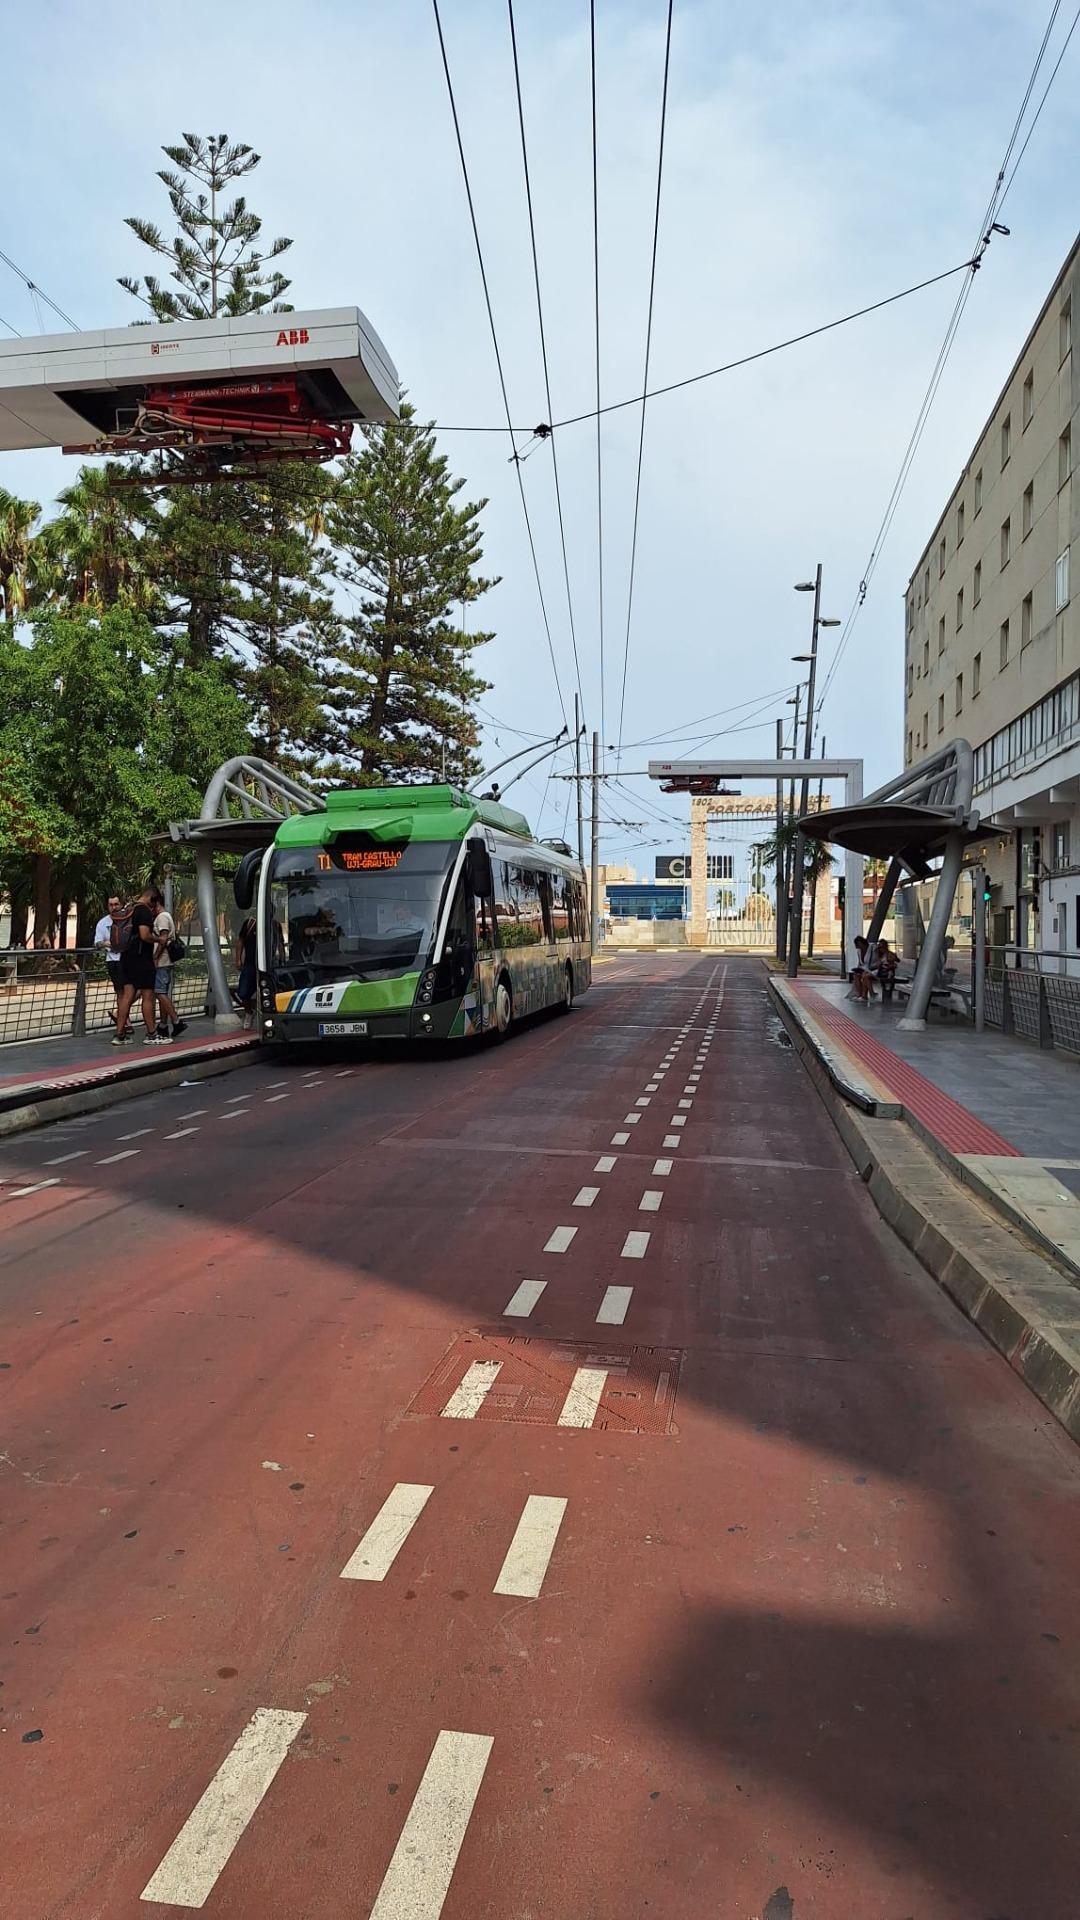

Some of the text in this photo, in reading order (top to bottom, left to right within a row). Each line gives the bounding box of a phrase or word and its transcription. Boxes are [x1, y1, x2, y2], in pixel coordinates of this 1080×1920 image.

[276, 329, 309, 346] ABB
[318, 854, 331, 870] T1
[342, 853, 362, 861] TRAM
[346, 859, 398, 869] UJI-GRAU-UJI
[325, 1024, 365, 1033] 3658 JBN
